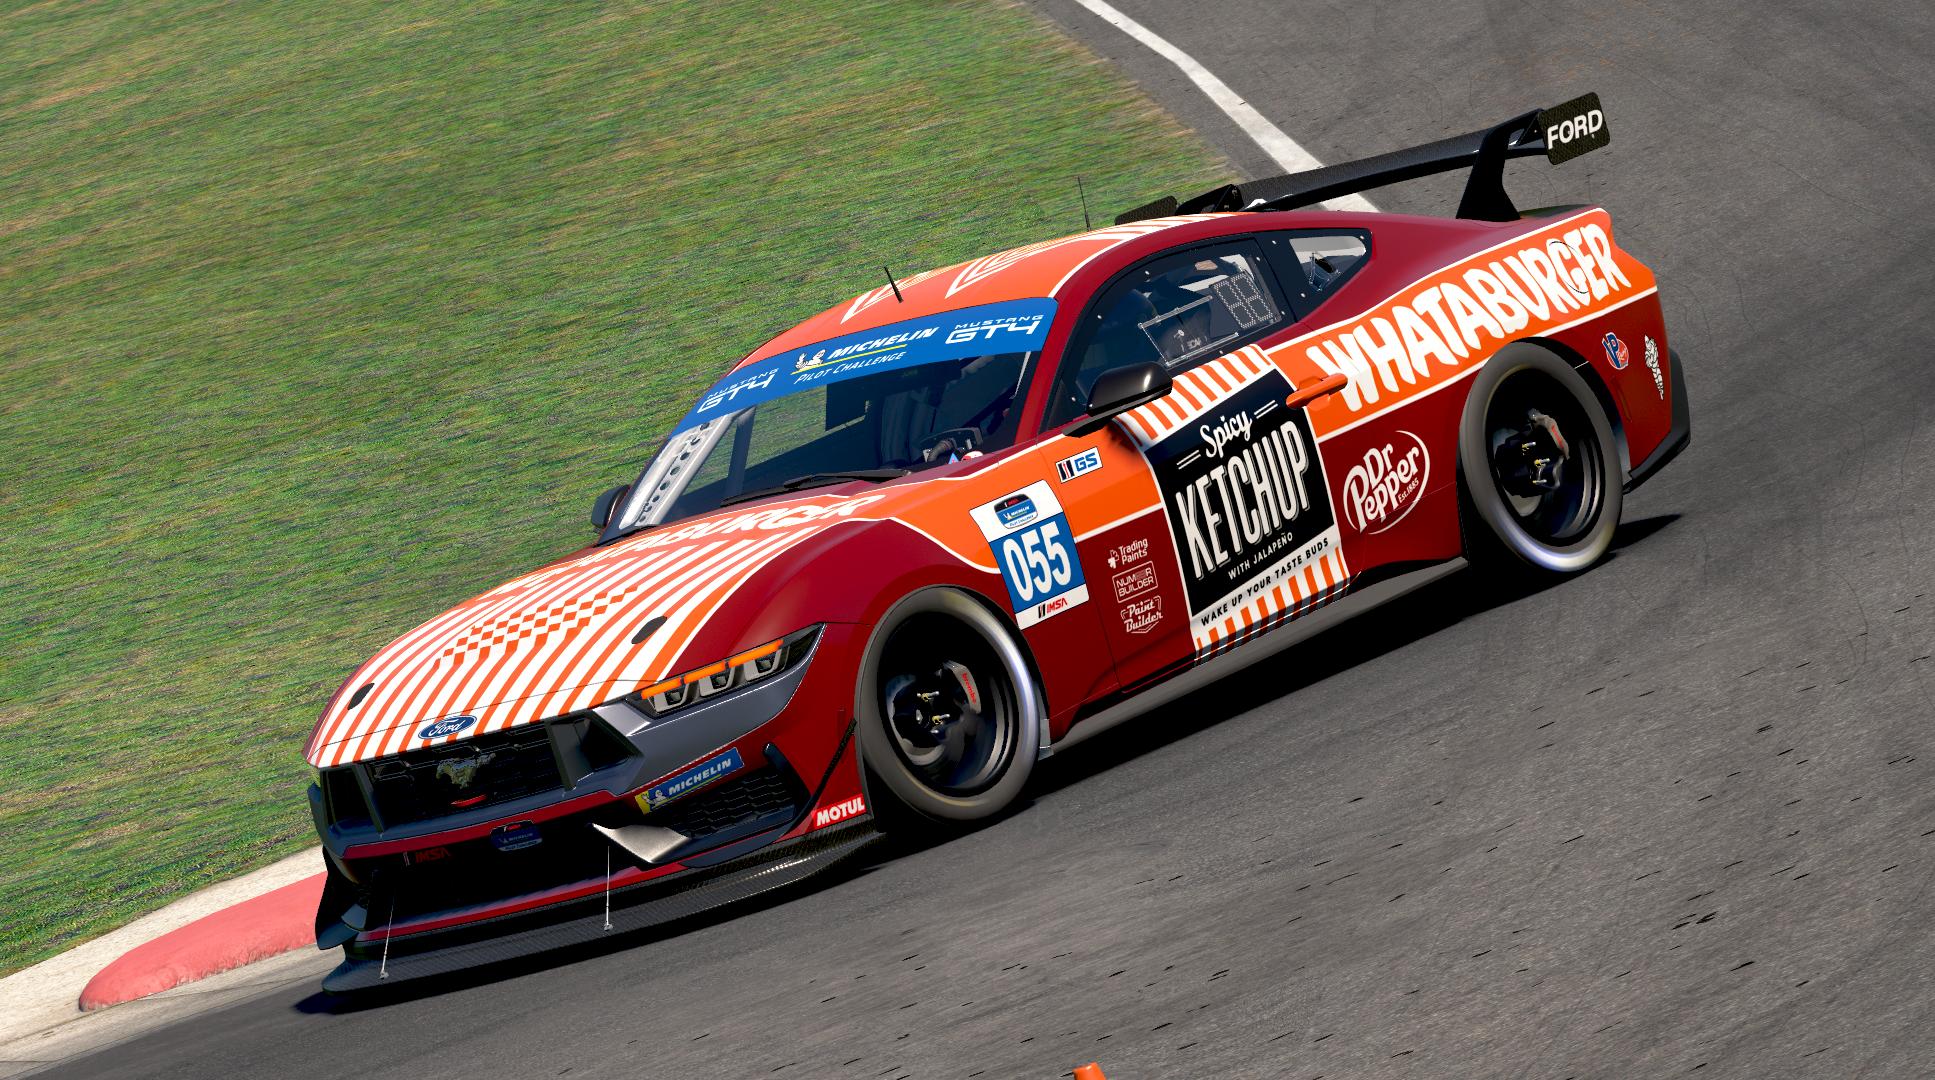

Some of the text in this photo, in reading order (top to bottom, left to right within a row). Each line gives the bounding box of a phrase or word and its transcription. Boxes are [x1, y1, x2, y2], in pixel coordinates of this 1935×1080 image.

[1547, 109, 1603, 150] FORD
[945, 320, 1041, 344] GT4
[954, 314, 1044, 329] MUSTANG
[1306, 223, 1632, 412] WHATABURGER
[827, 326, 940, 360] MICHELIN
[793, 351, 907, 384] PILOT CHALLENGE
[697, 373, 774, 413] GT4
[1200, 411, 1253, 458] Spicy
[1074, 452, 1098, 472] GS
[1362, 443, 1394, 490] Dr
[1175, 420, 1310, 580] KETCHUP
[1343, 446, 1420, 533] Pepper
[1003, 520, 1072, 601] 055
[1118, 538, 1149, 556] Trading
[1121, 548, 1148, 565] Paints
[1227, 531, 1294, 580] WITH JALAPEÑO
[1118, 576, 1155, 597] BUILDER
[1201, 537, 1329, 627] WAKE UP YOUR TASTE BUDS
[1046, 598, 1068, 614] IMSA
[1123, 611, 1164, 633] Builder
[1126, 600, 1156, 618] Paint
[427, 717, 467, 737] Ford
[668, 758, 733, 796] MICHELIN
[816, 797, 865, 827] MOTUL
